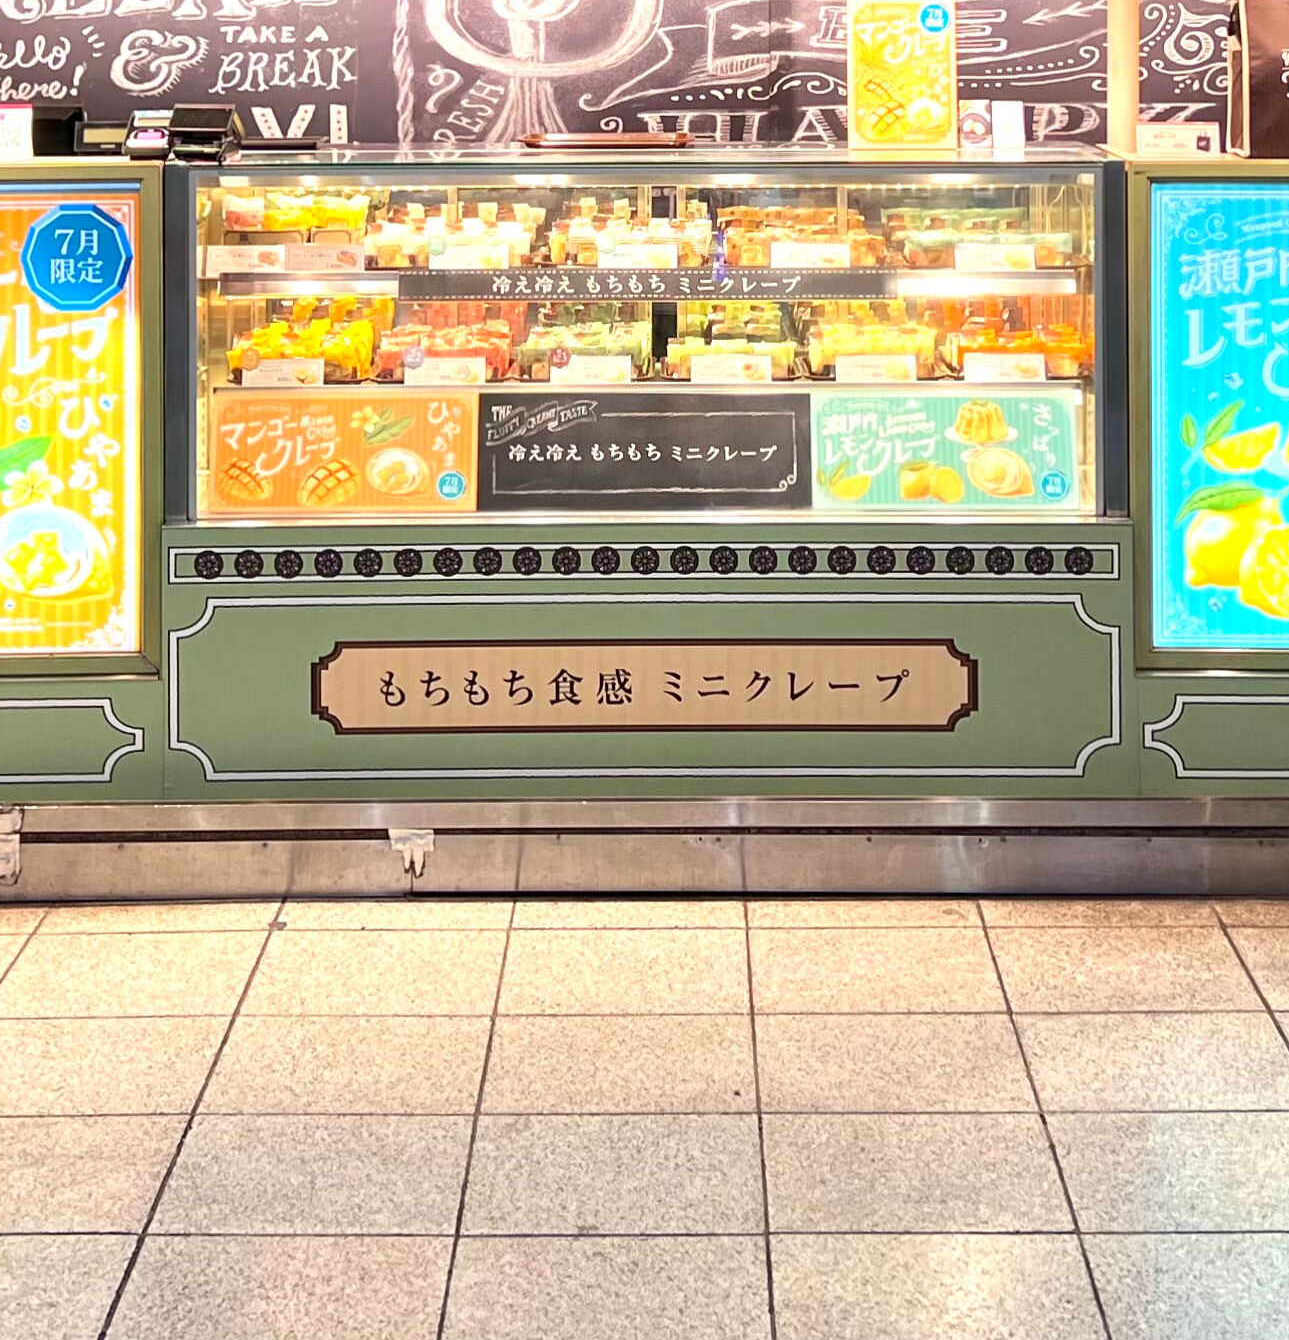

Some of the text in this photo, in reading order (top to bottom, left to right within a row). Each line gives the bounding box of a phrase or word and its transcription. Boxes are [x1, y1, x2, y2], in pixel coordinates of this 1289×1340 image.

[220, 26, 330, 44] TAKE A
[209, 45, 357, 94] BREAK
[54, 229, 98, 256] 7月
[50, 258, 103, 284] 限定
[492, 273, 802, 295] 冷え冷え もちもち ミニクレープ
[508, 443, 778, 462] 冷え冷え もちもち ミニクレープ
[379, 669, 910, 707] もちもち食感 ミニクレープ
